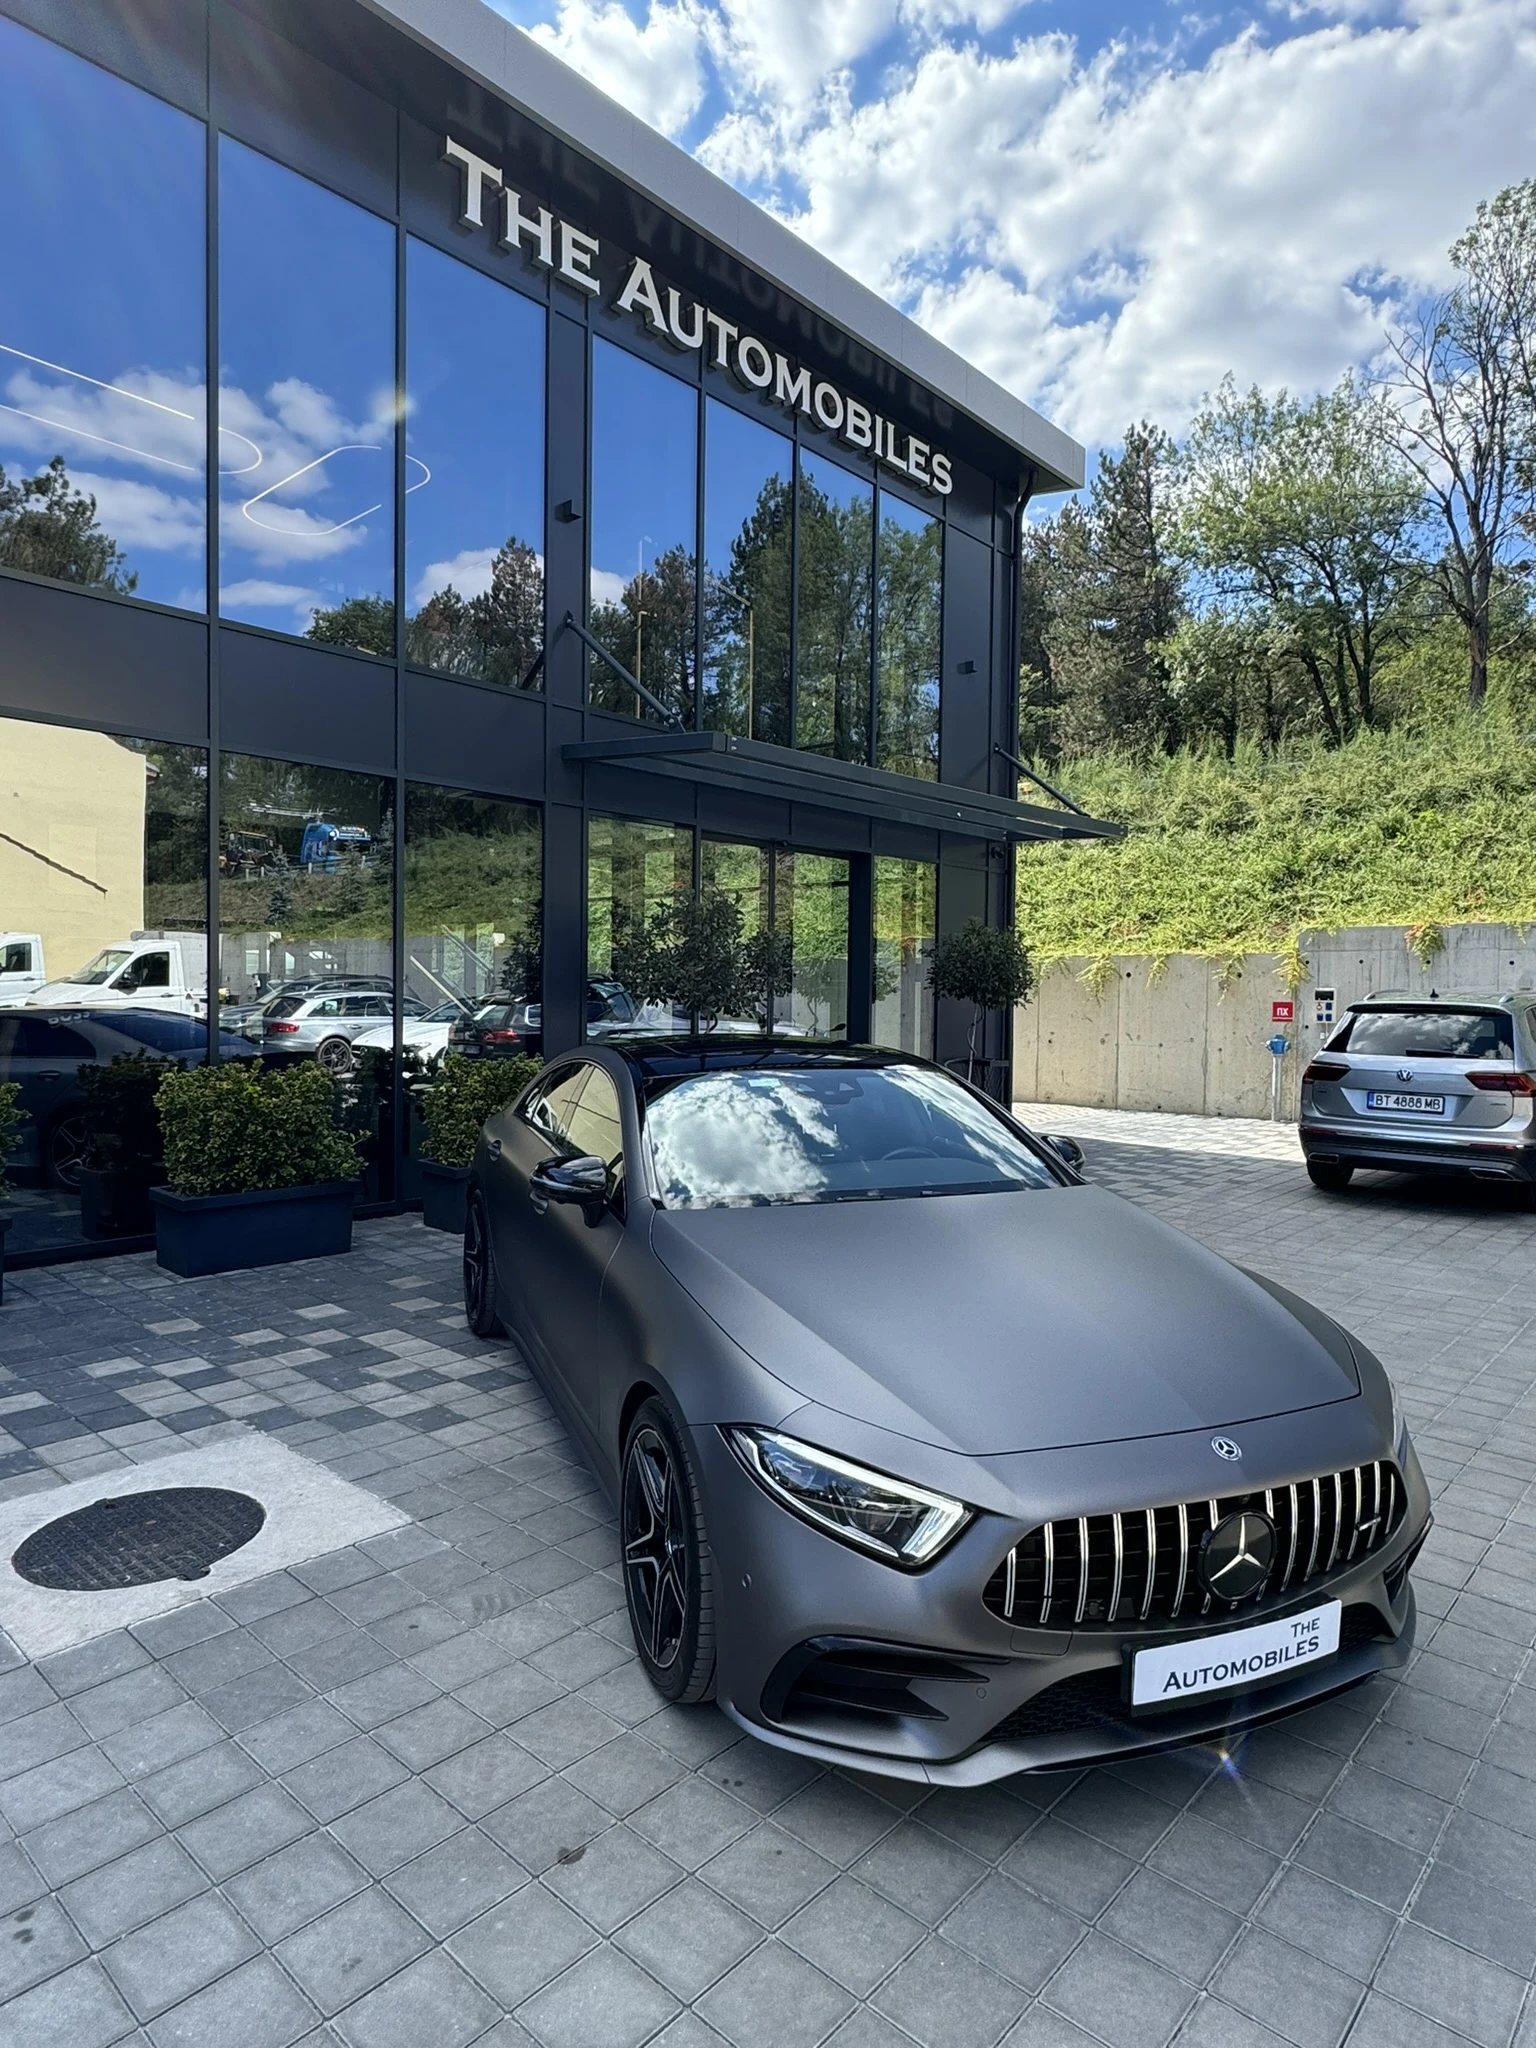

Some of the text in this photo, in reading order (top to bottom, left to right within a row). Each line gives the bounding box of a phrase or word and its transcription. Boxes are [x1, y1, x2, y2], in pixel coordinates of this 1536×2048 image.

[446, 136, 600, 295] THE
[617, 257, 953, 495] AUTOMOBILES
[1376, 1095, 1441, 1110] BT 4888 MB
[1291, 1617, 1320, 1637] THE
[1162, 1636, 1319, 1693] AUTOMOBILES
